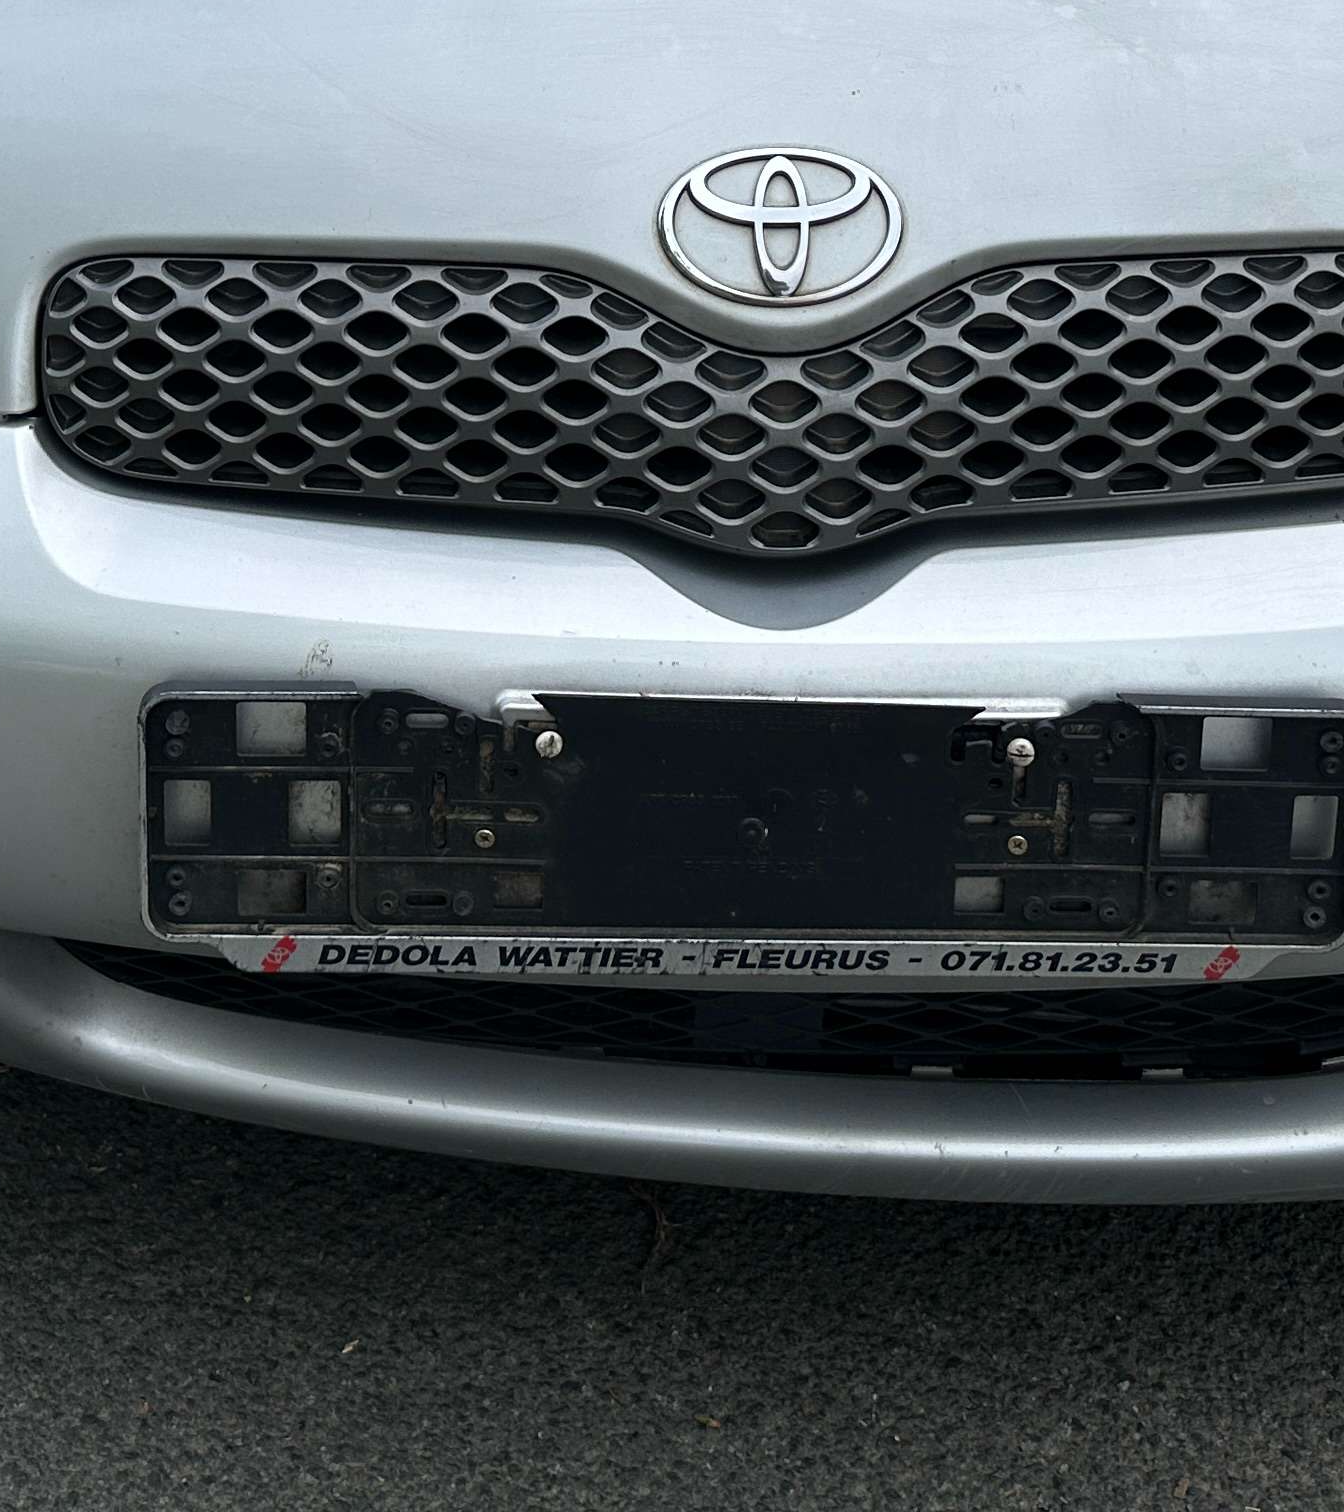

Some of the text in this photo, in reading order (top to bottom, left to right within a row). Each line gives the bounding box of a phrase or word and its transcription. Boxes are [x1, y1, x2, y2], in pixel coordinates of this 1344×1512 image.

[317, 944, 477, 967] DEDOLA
[498, 945, 664, 969] WATTIER
[712, 947, 891, 970] FLEURUS
[940, 950, 1178, 973] 071.81.23.51
